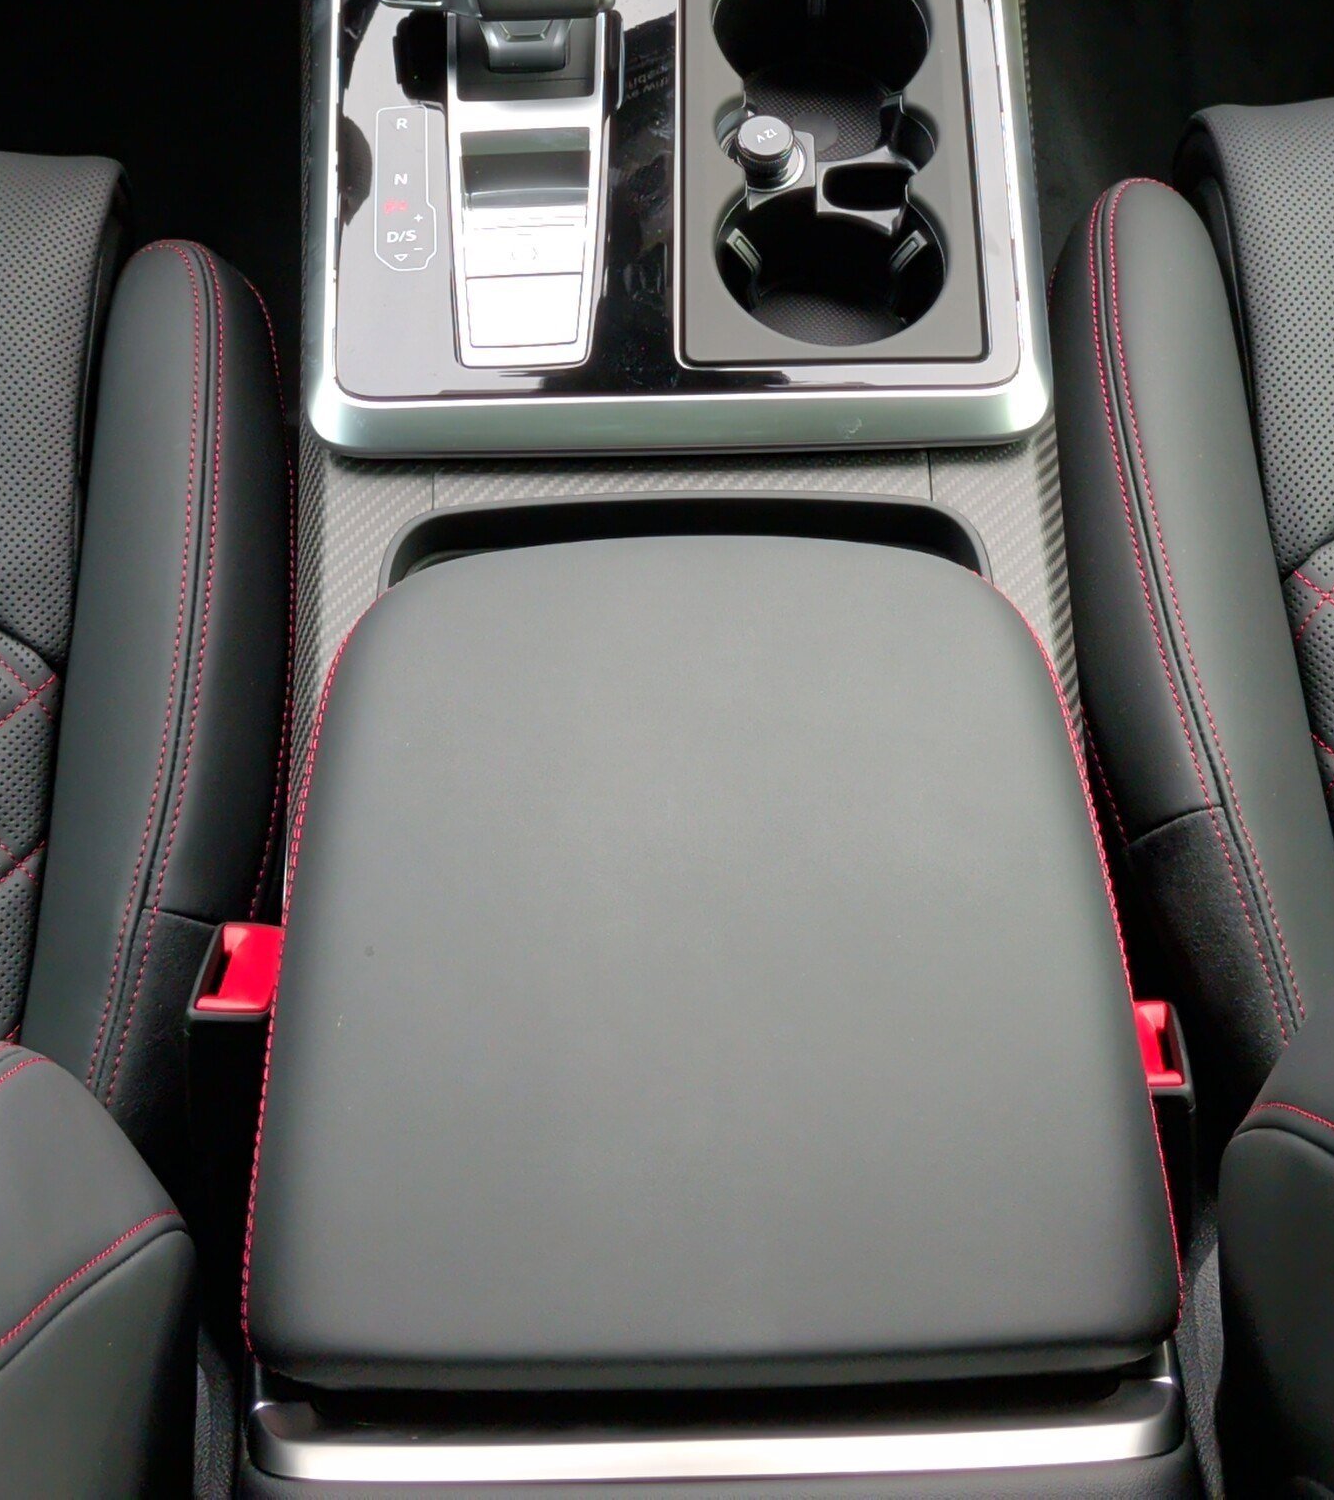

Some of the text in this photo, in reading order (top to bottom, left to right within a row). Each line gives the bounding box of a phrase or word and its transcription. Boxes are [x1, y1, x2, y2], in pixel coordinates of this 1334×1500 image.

[396, 117, 408, 130] R
[756, 128, 778, 144] 12 V
[394, 173, 408, 186] N
[386, 229, 417, 244] D/S
